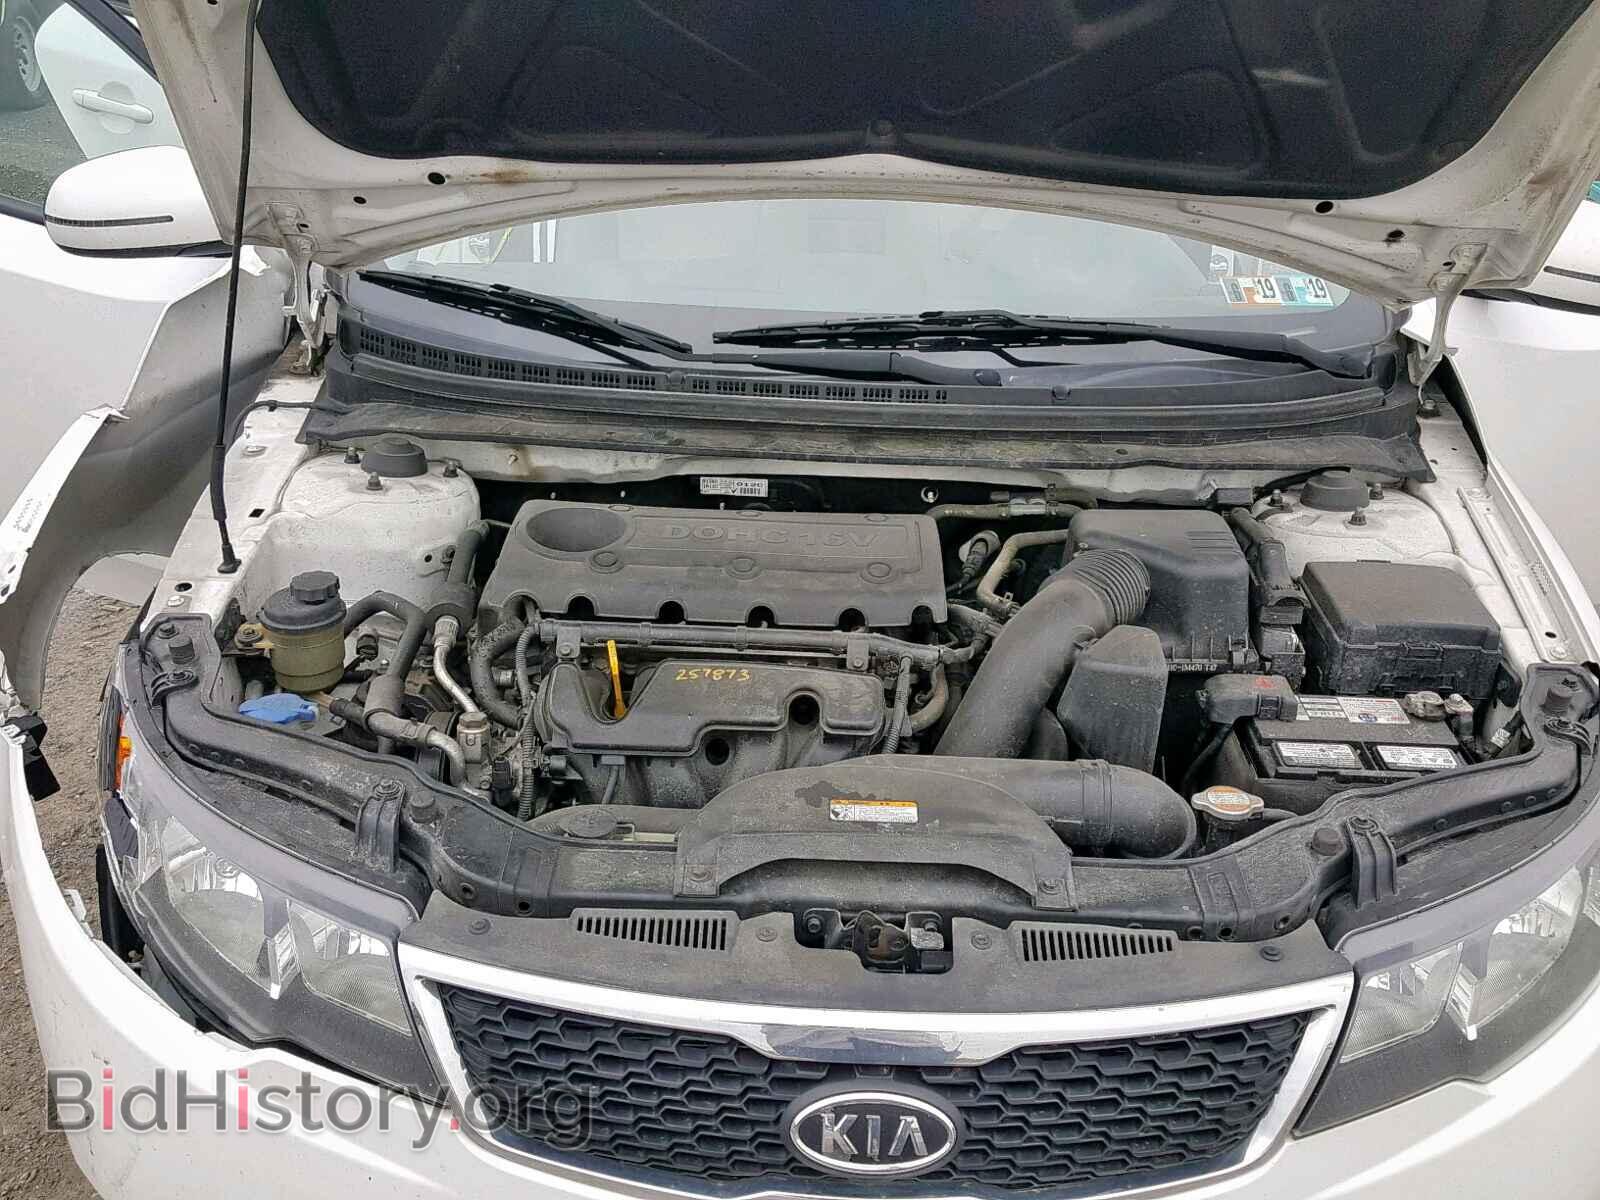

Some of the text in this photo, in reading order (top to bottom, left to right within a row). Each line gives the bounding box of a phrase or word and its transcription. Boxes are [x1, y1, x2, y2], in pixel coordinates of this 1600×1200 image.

[1257, 278, 1276, 299] 19
[1309, 277, 1327, 299] 19
[663, 525, 879, 548] DOHC 16V
[675, 668, 750, 682] 257873
[821, 1112, 929, 1157] KIA
